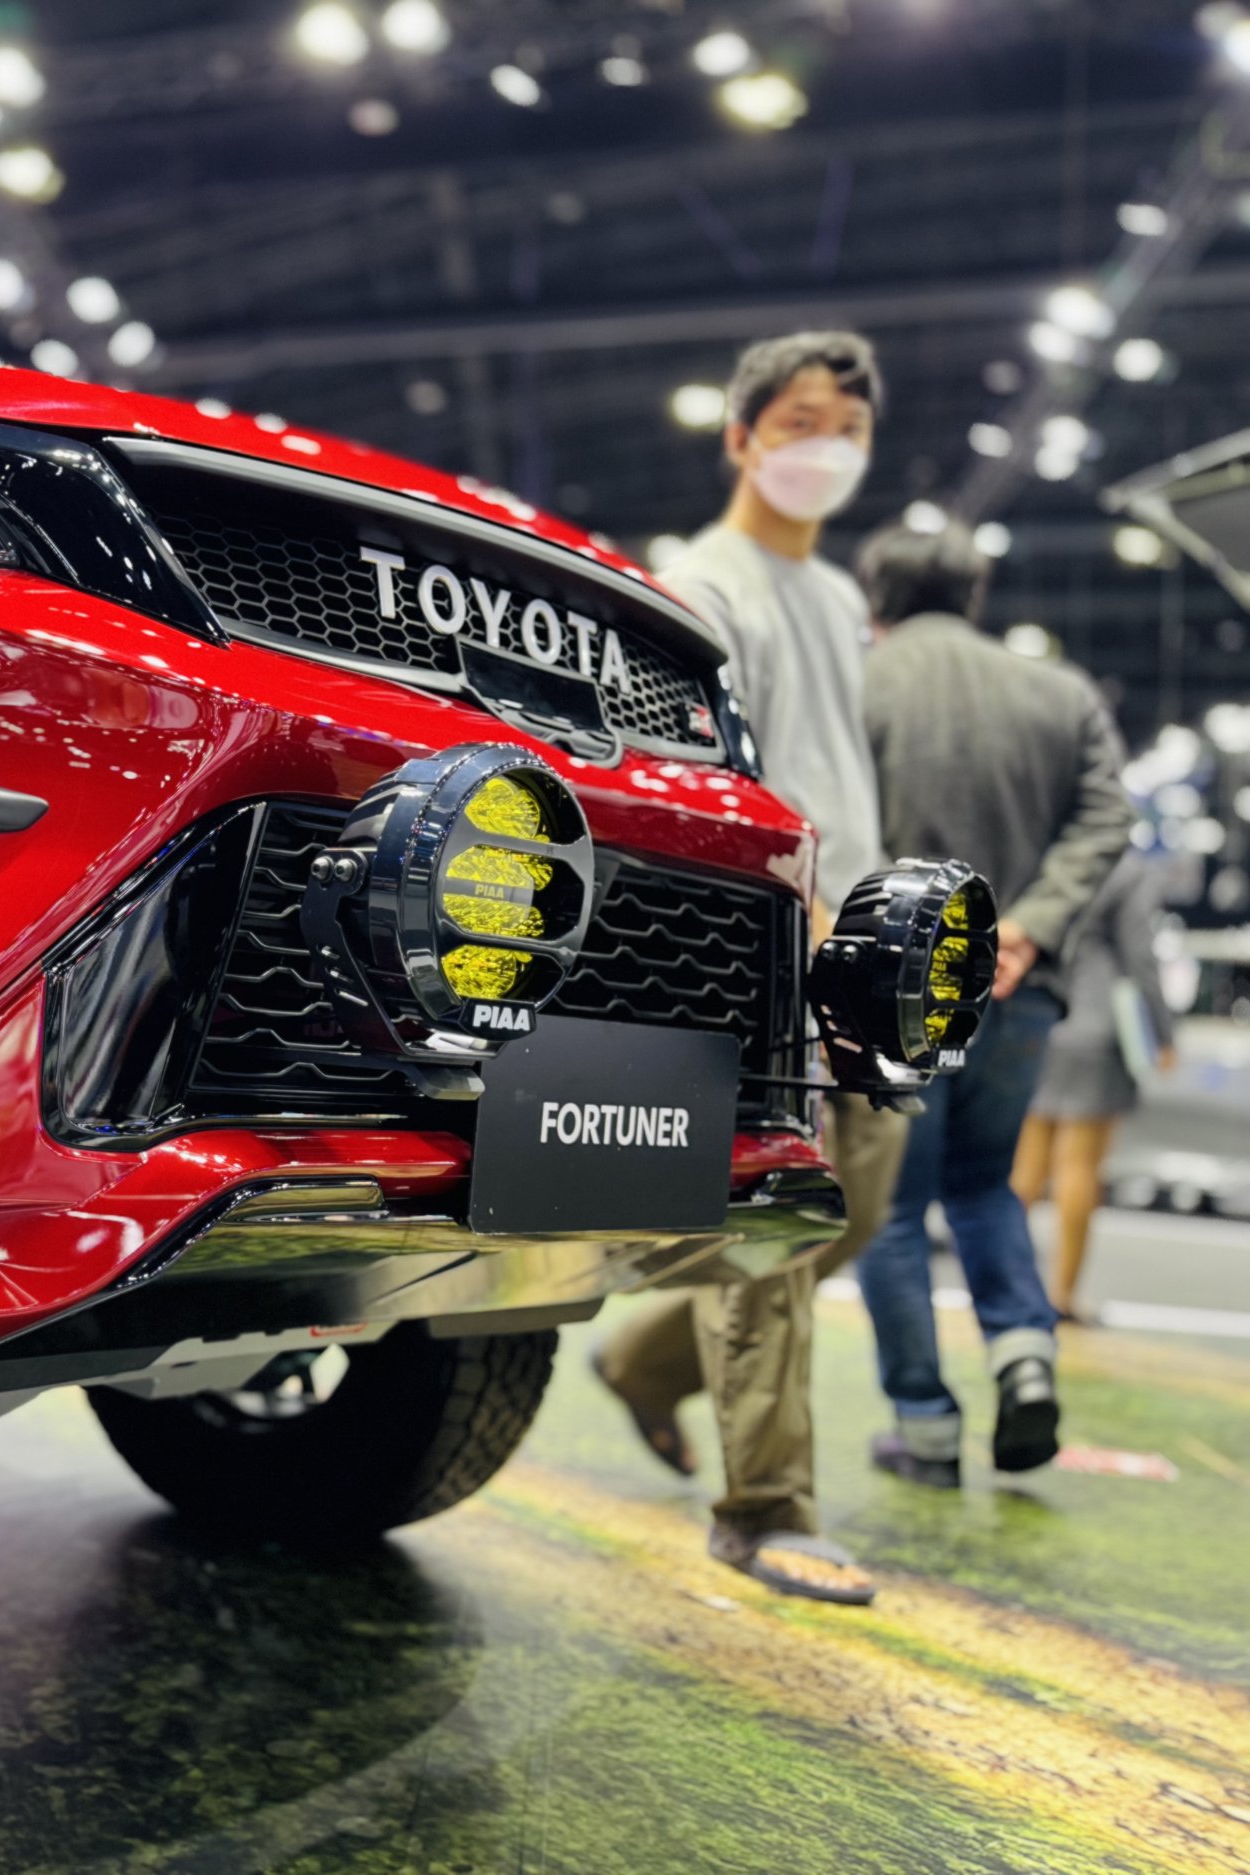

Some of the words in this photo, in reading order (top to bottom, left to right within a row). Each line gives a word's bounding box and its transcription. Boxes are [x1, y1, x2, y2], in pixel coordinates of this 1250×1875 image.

[359, 546, 631, 694] TOYOTA
[474, 883, 505, 899] PIAA
[472, 1004, 531, 1032] PIAA
[937, 1049, 966, 1067] PIAA
[540, 1102, 690, 1148] FORTUNER
